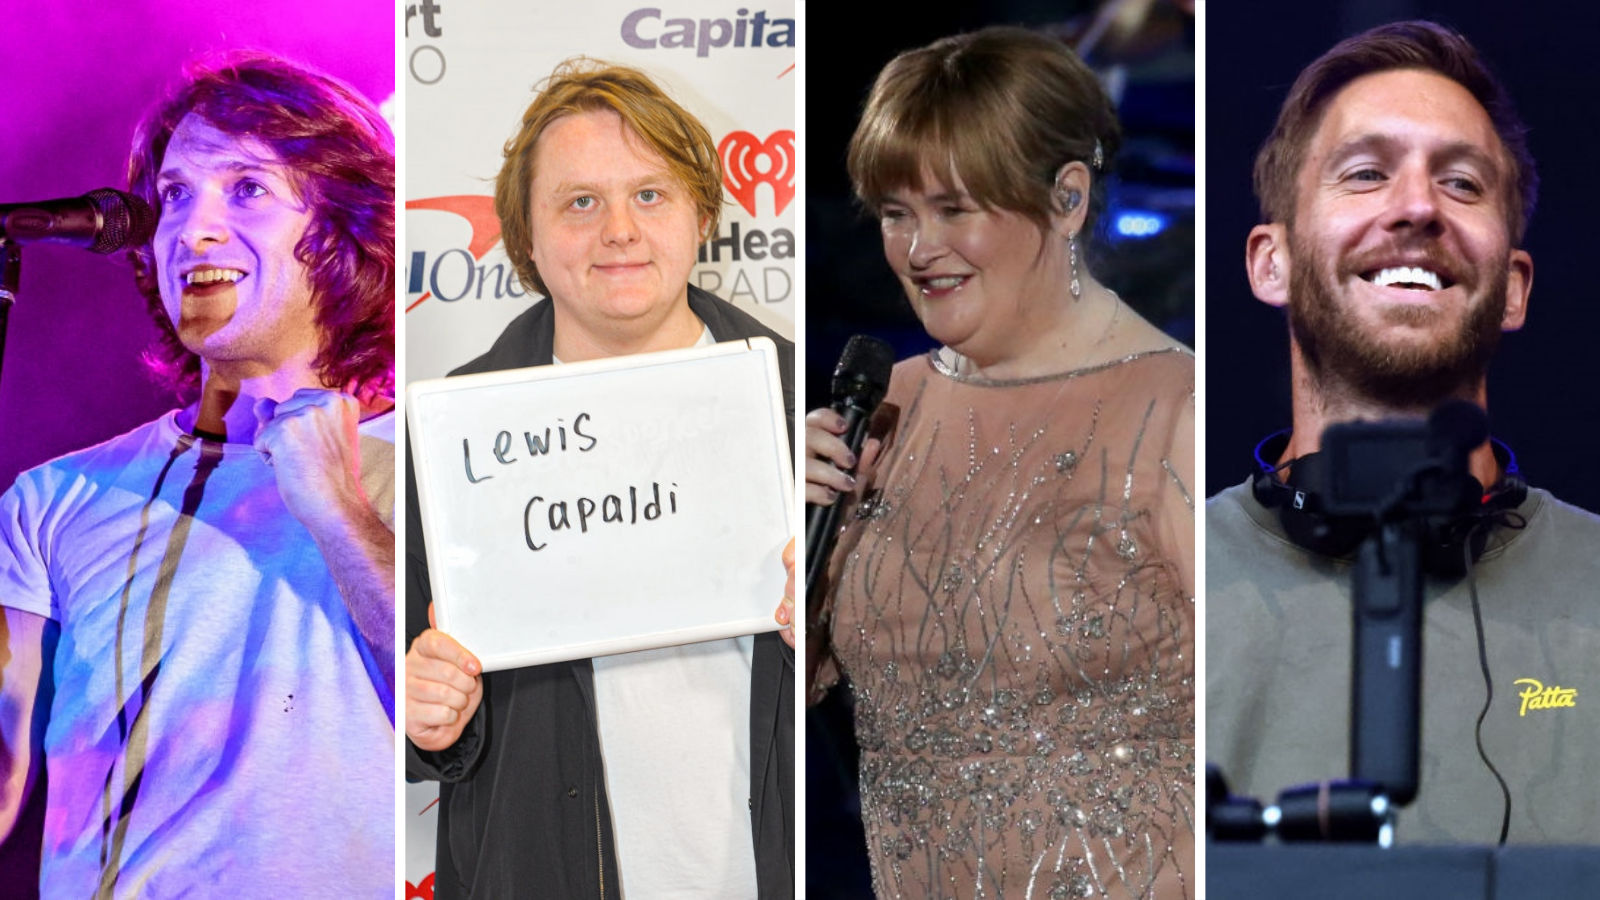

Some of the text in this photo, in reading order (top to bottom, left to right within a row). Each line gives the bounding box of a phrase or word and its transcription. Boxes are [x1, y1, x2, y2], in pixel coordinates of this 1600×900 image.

[620, 7, 795, 58] Capita
[462, 412, 598, 484] Lewis
[523, 481, 678, 551] Capaldi
[1513, 678, 1578, 717] Patta
